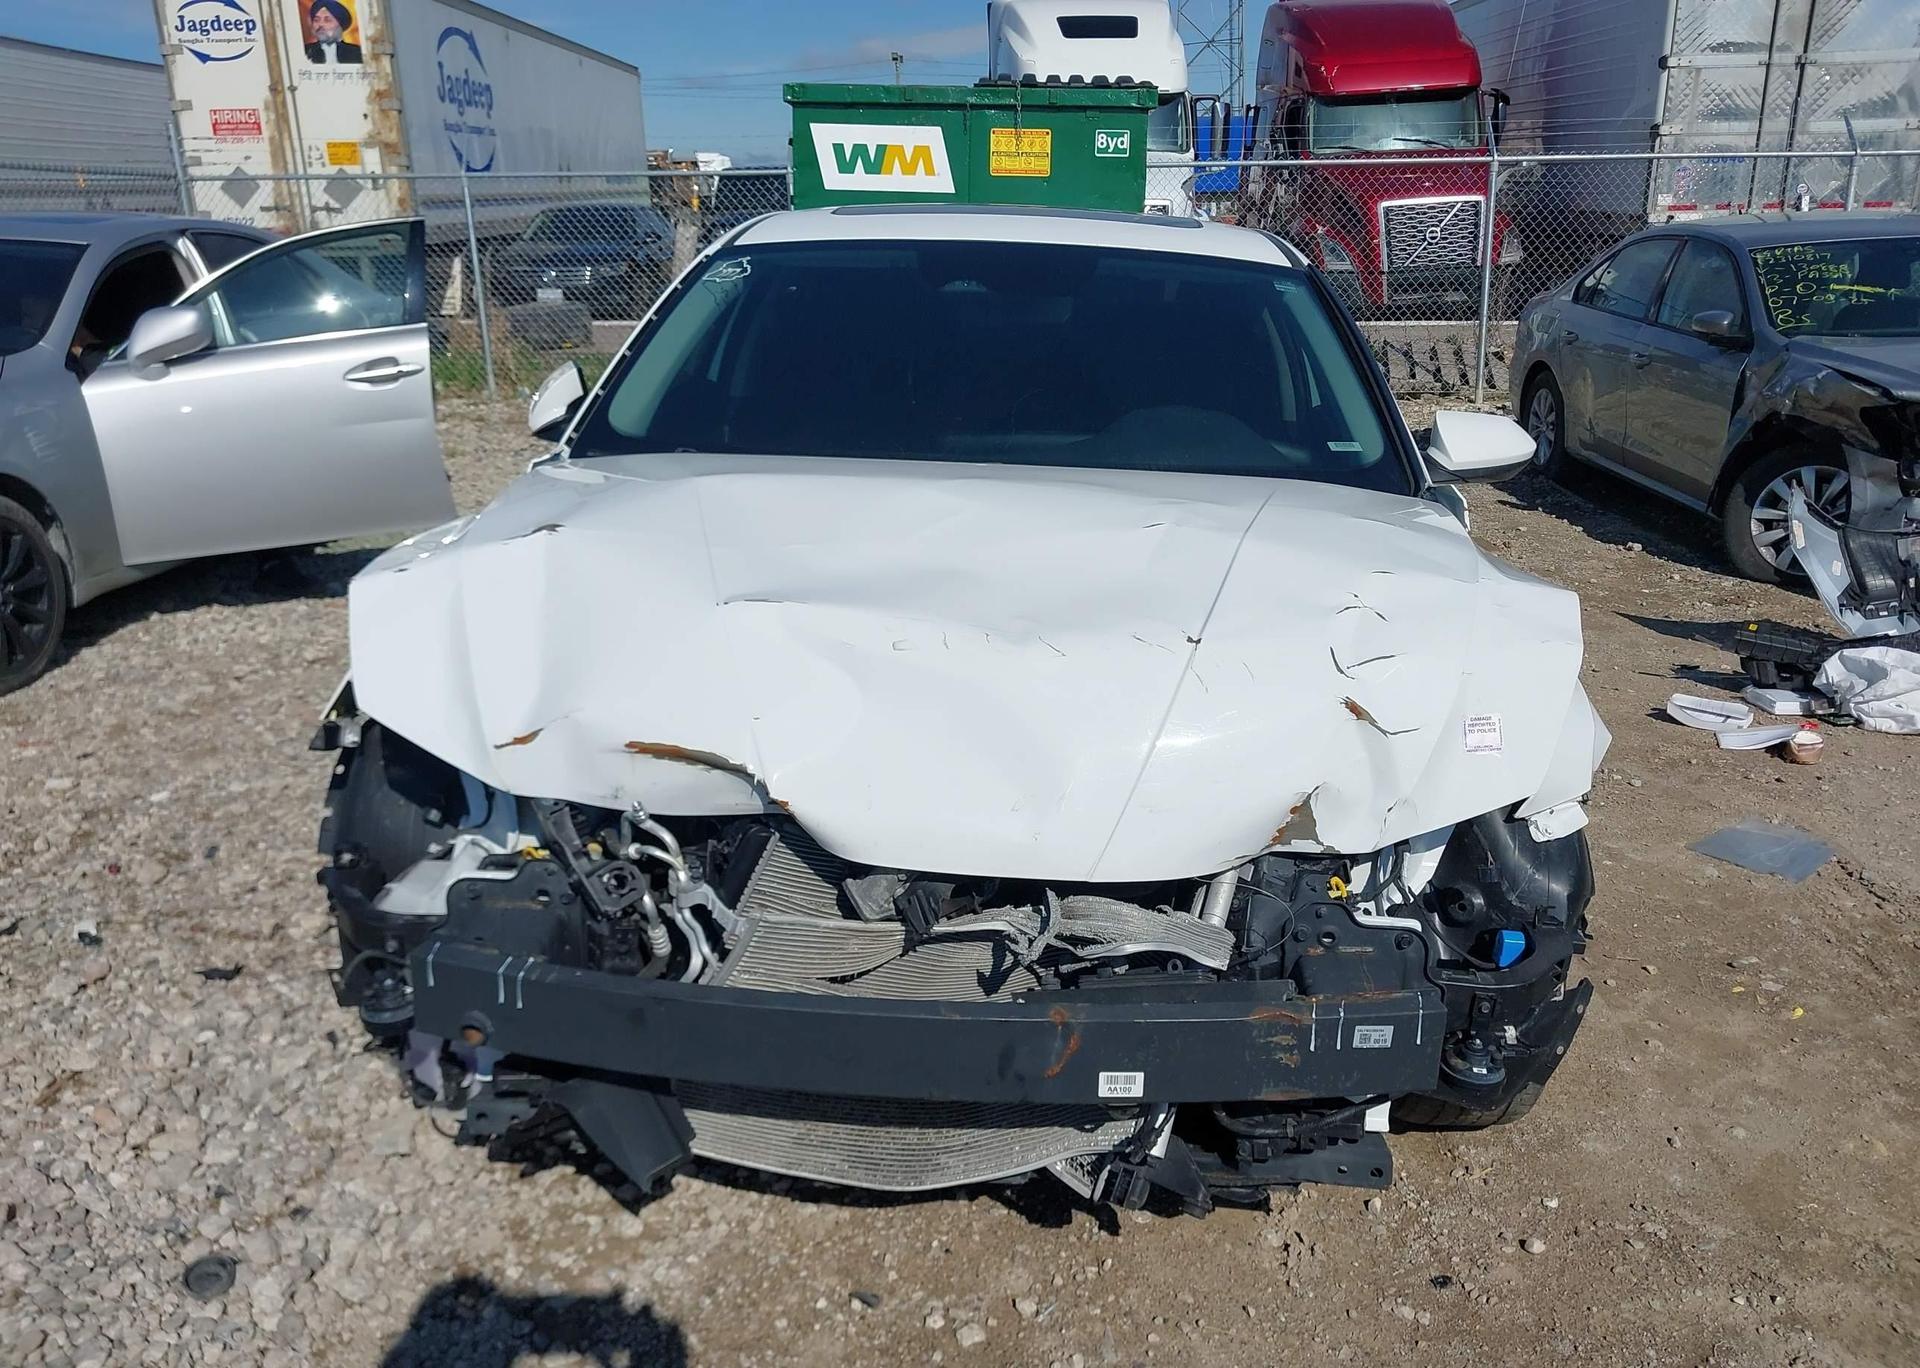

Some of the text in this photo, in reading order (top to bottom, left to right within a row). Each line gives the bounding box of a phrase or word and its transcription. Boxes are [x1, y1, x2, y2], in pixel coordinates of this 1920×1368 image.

[174, 15, 257, 36] Jagdeep
[437, 61, 494, 120] Jagdeep
[210, 109, 260, 123] HIRING!
[1097, 133, 1128, 152] 8yd
[832, 143, 936, 176] WM
